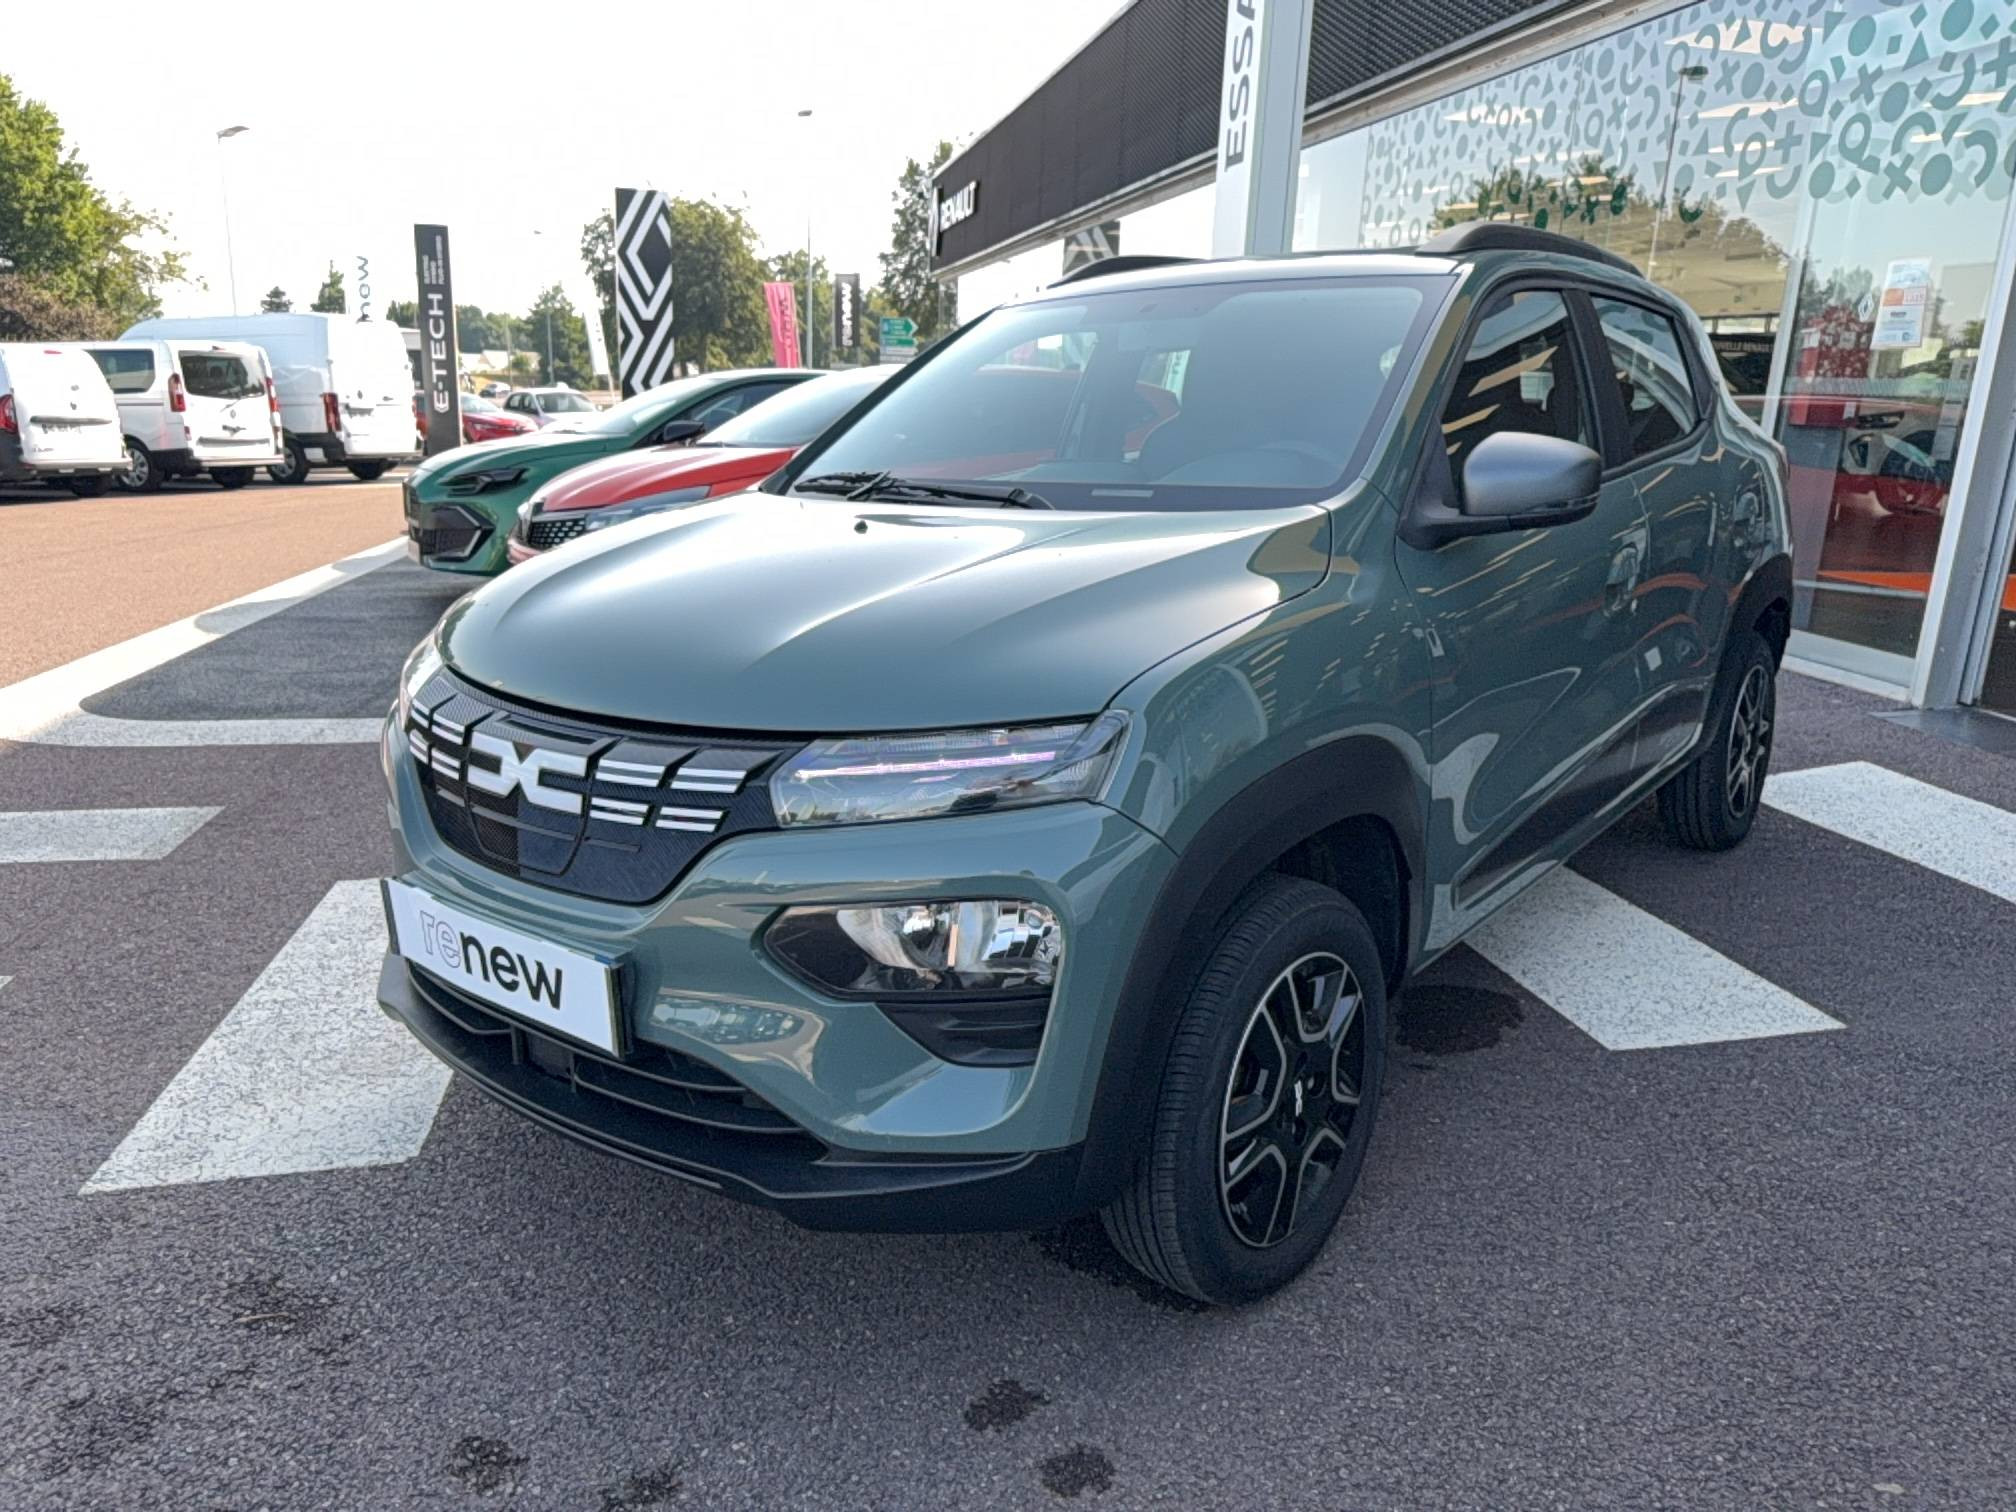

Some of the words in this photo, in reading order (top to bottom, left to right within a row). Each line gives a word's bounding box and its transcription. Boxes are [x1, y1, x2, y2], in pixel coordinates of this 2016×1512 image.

[940, 181, 977, 232] RENAULT
[427, 293, 450, 413] E-TECH
[420, 910, 563, 1010] renew
